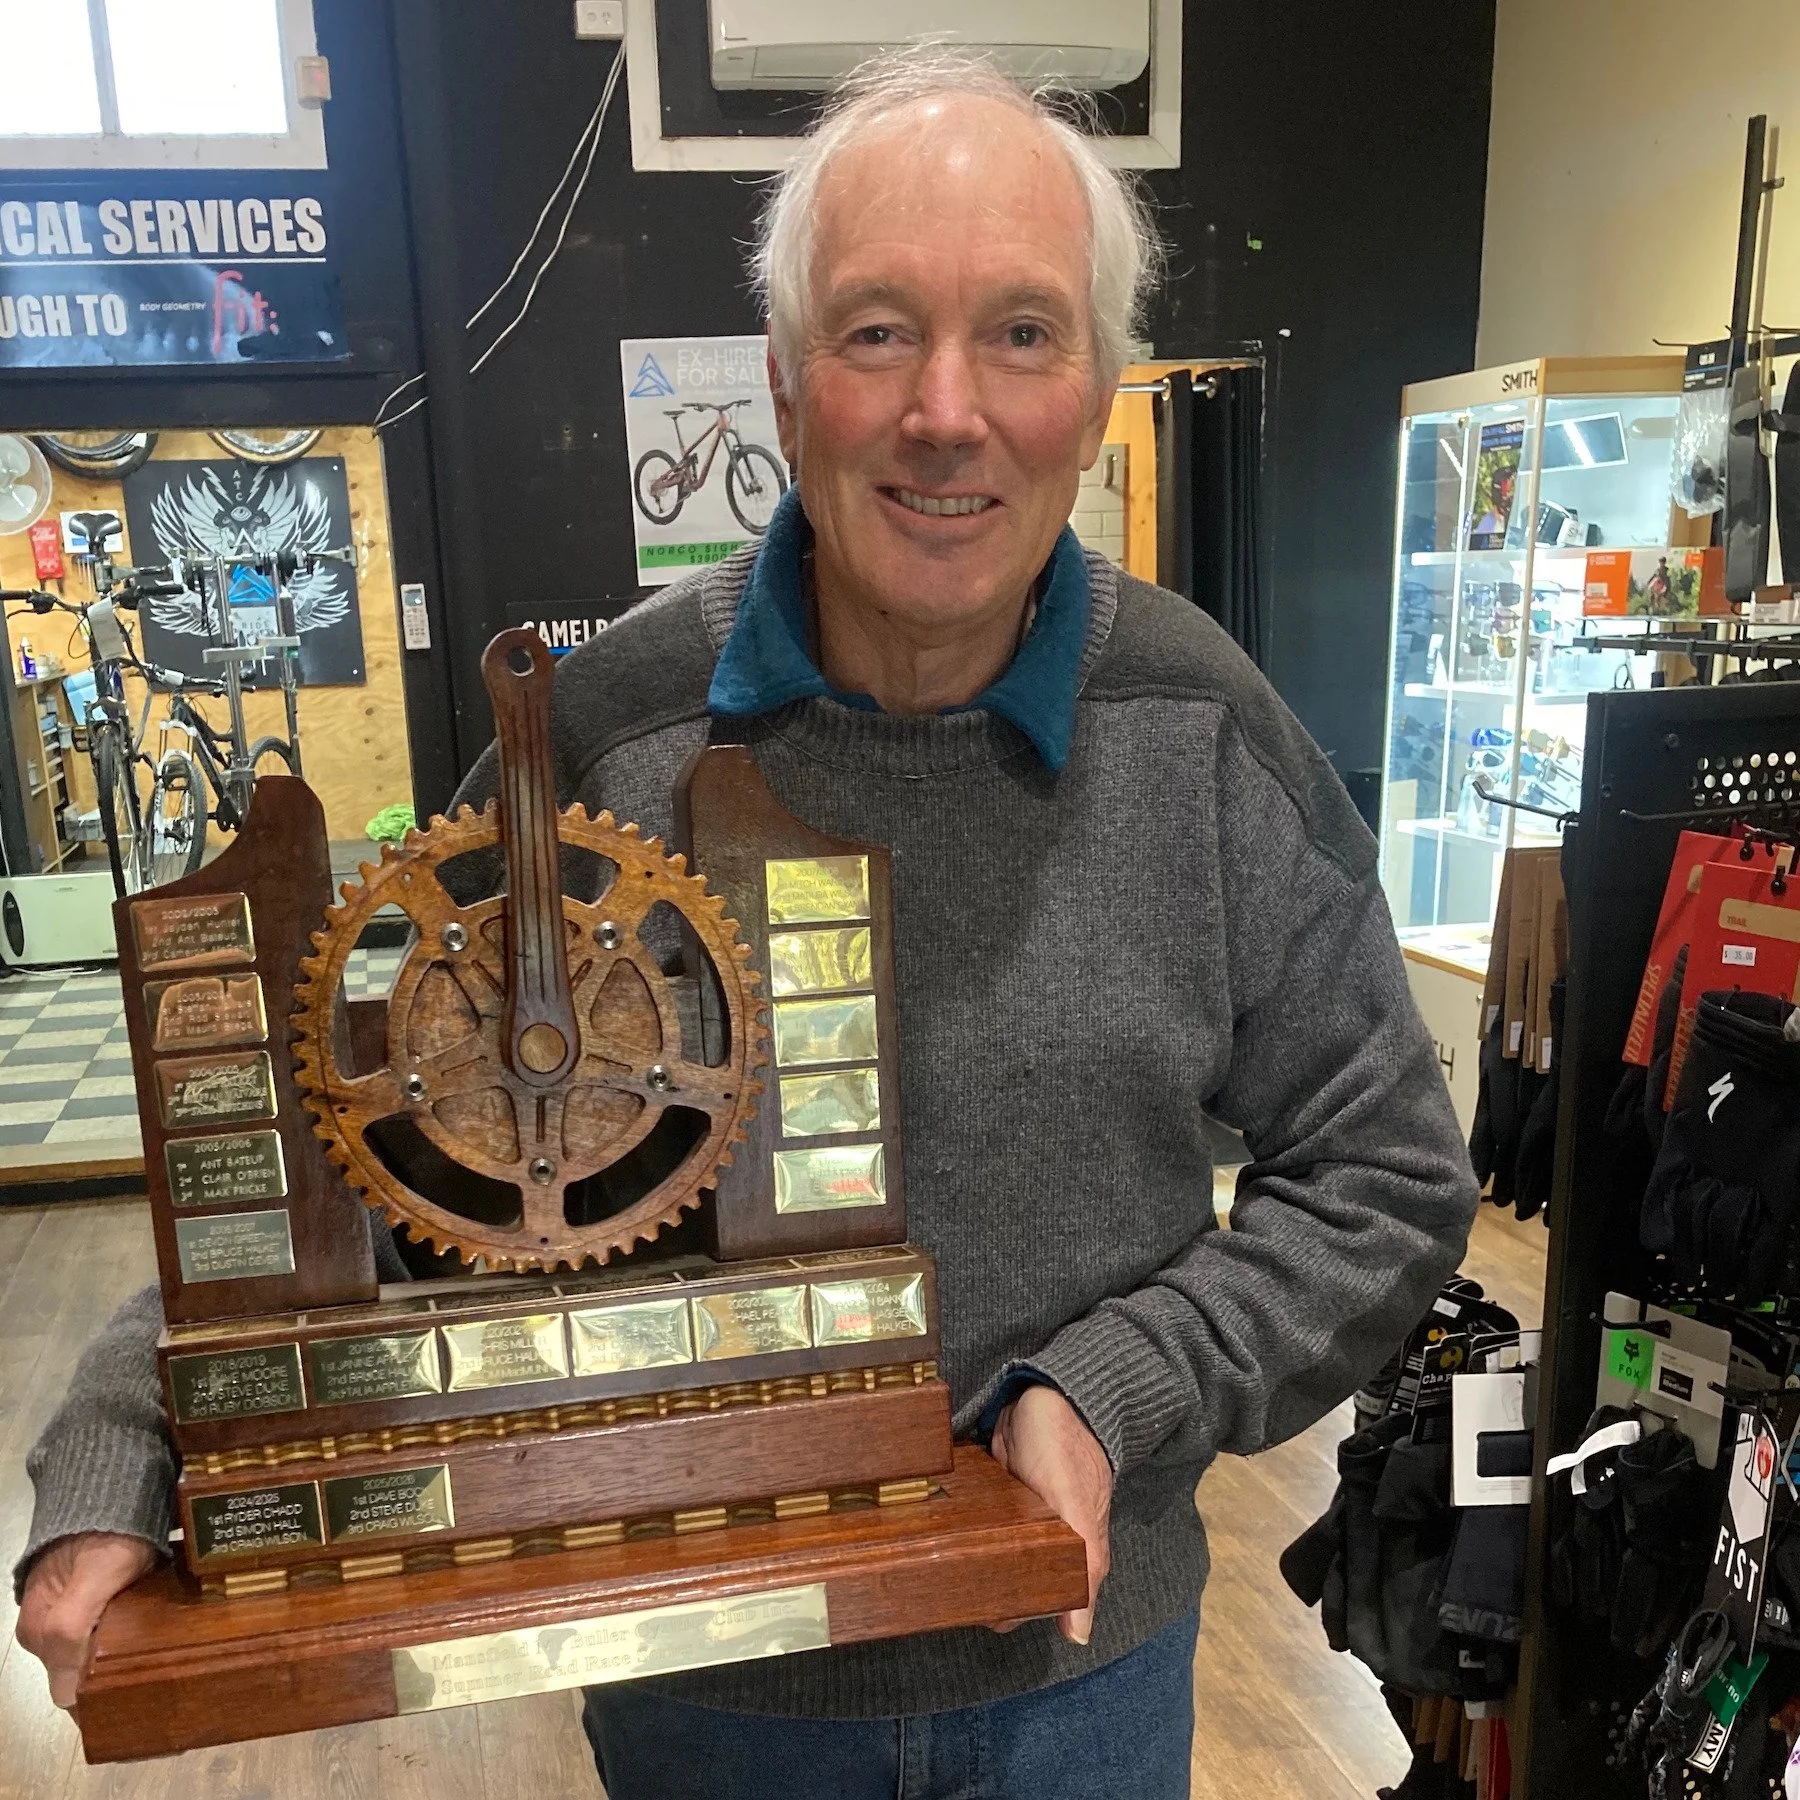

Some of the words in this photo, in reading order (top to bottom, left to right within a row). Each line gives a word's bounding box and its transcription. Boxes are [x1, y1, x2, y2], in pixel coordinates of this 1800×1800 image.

[0, 200, 92, 255] CAL
[99, 197, 326, 253] SERVICES
[76, 293, 127, 337] TO
[140, 302, 160, 311] BODY
[162, 302, 206, 312] GEOMETRY
[676, 367, 718, 387] FOR
[724, 366, 768, 386] SAL
[1502, 368, 1539, 393] SMITH
[646, 544, 697, 556] NORCO
[194, 1139, 252, 1154] 2005/2006
[199, 1158, 223, 1170] ANT
[201, 1172, 232, 1185] CLAIR
[203, 1187, 229, 1199] MAX
[209, 1246, 243, 1259] BRUCE
[207, 1354, 267, 1373] 2018/2019
[1618, 1362, 1642, 1380] FOX
[241, 1365, 288, 1383] MOORE
[217, 1384, 254, 1400] STEVE
[255, 1379, 290, 1395] DUKE
[208, 1400, 241, 1415] RUBY
[226, 1492, 281, 1510] 2024/2025
[353, 1495, 368, 1506] 1st
[368, 1490, 398, 1504] DAVE
[207, 1515, 224, 1526] 1st
[224, 1508, 263, 1524] RYDER
[263, 1503, 304, 1519] CHADD
[349, 1508, 370, 1521] 2nd
[370, 1503, 404, 1518] STEVE
[213, 1527, 235, 1540] 2nd
[235, 1522, 272, 1537] SIMON
[273, 1517, 302, 1532] HALL
[365, 1518, 399, 1532] CRAIG
[400, 1512, 435, 1527] WILSO
[229, 1537, 264, 1552] CRAIG
[264, 1531, 308, 1547] WILSON
[1714, 1525, 1759, 1602] FIST
[432, 1641, 530, 1671] Mansfield
[570, 1626, 631, 1651] Buller
[713, 1605, 758, 1627] Club
[440, 1667, 525, 1696] Summer
[527, 1659, 579, 1682] Road
[584, 1652, 632, 1676] Race
[1702, 1719, 1724, 1760] MY
